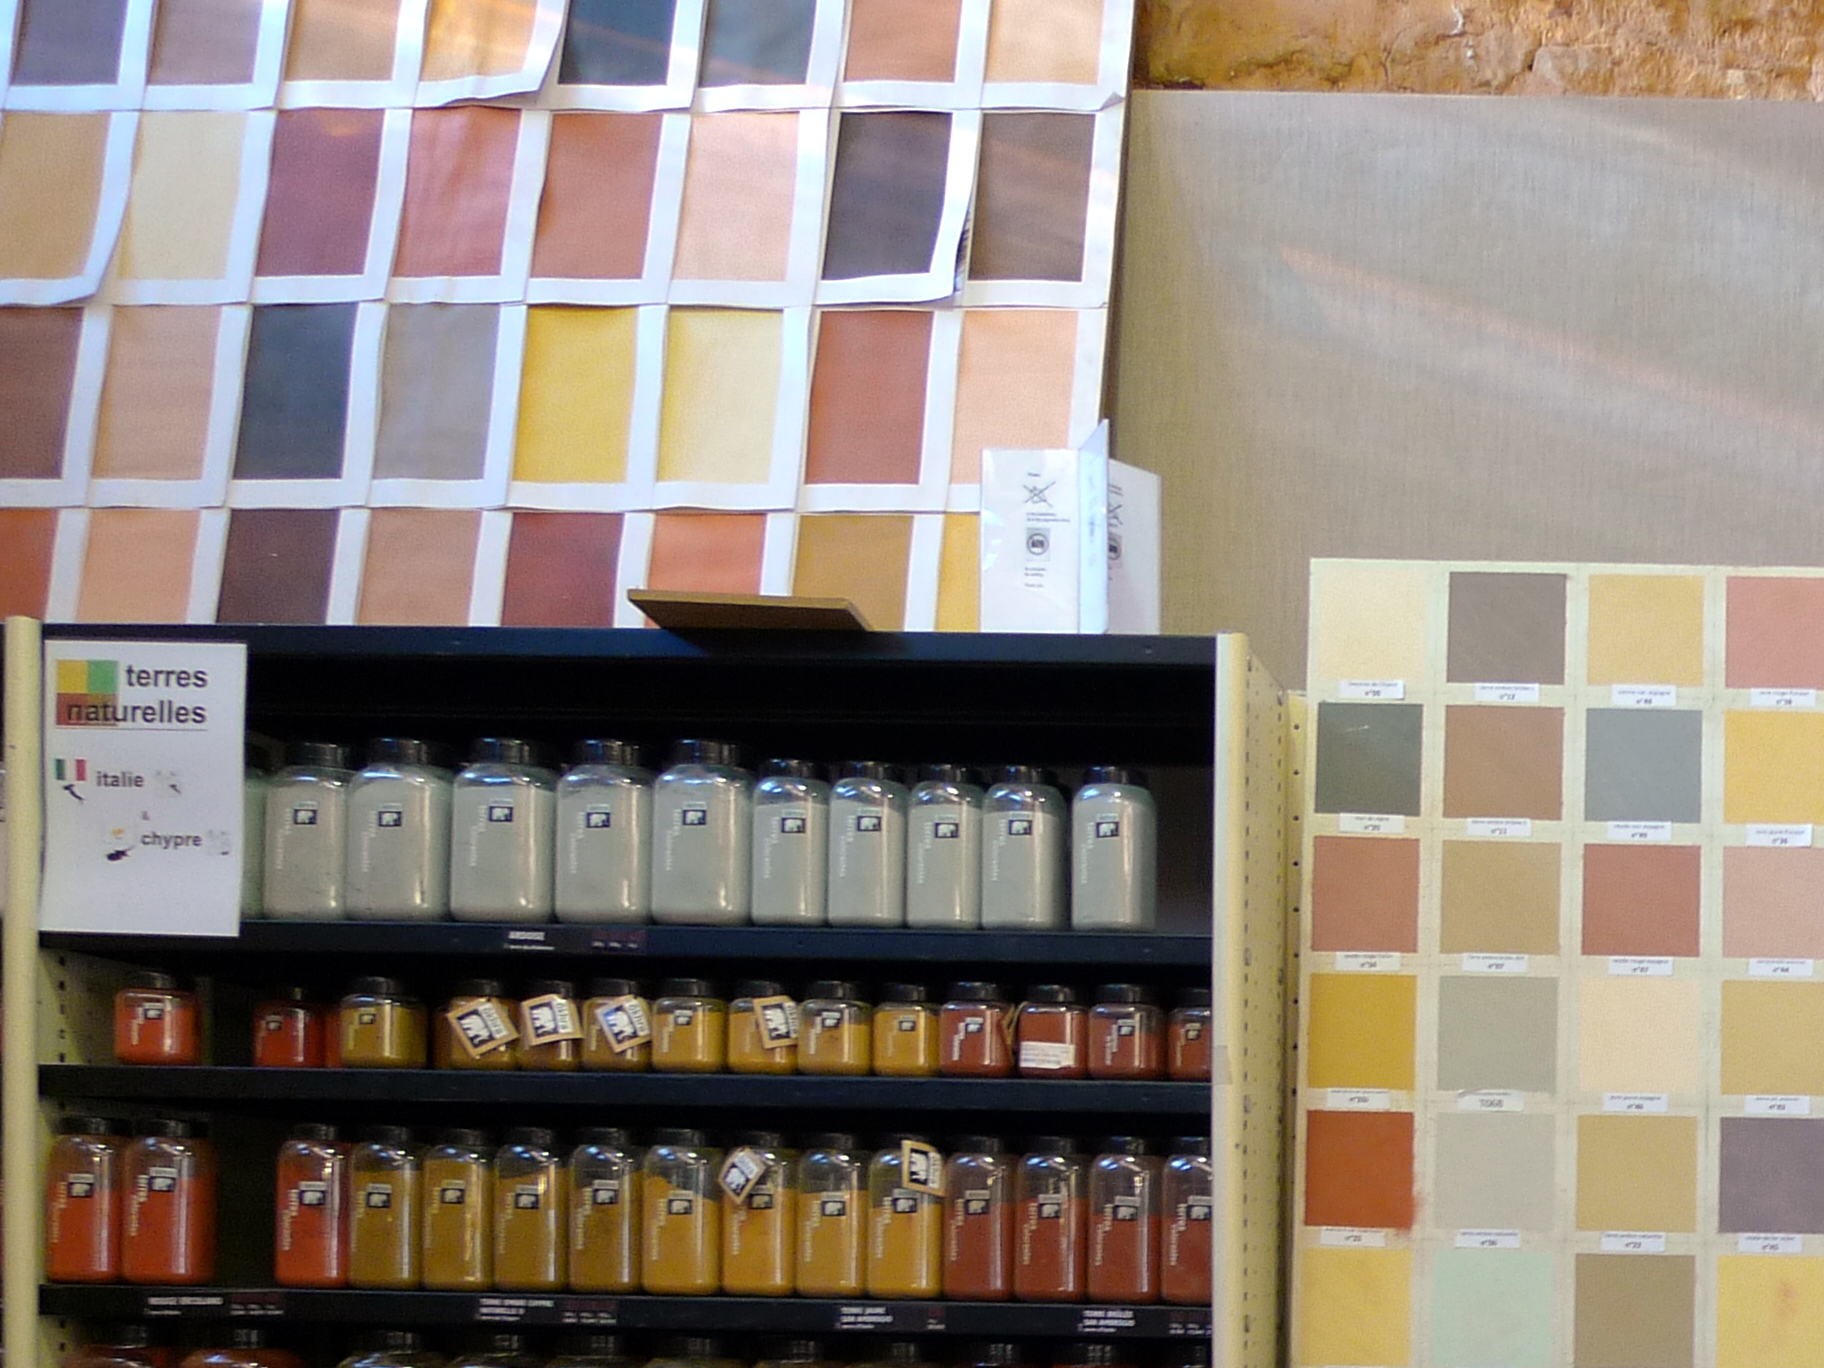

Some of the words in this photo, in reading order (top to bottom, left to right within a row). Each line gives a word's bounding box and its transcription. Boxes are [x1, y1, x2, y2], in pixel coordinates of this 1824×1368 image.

[126, 663, 208, 689] terres
[66, 697, 207, 725] naturelles
[96, 770, 145, 788] italie
[140, 831, 203, 850] chypre
